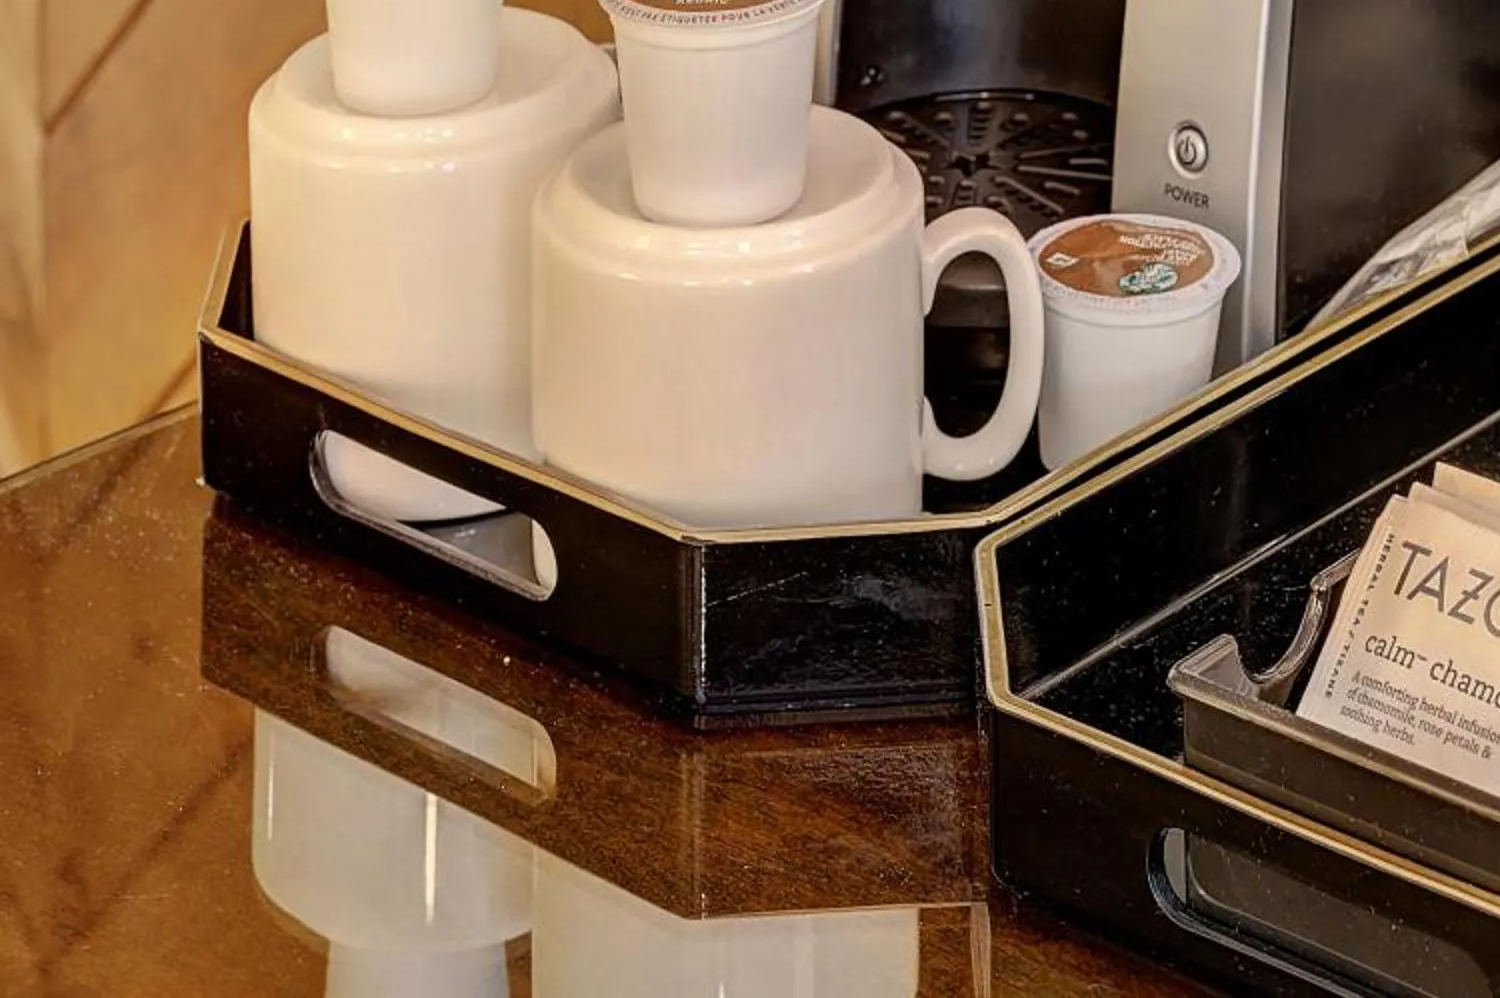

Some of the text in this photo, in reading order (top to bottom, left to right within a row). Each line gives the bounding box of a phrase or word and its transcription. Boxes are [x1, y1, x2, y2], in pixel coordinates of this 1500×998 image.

[1164, 182, 1210, 209] POWER
[1340, 704, 1384, 733] soothing
[1351, 670, 1361, 683] A
[1361, 674, 1420, 710] comforting
[1419, 696, 1458, 725] herbal
[1347, 687, 1361, 700] of
[1418, 718, 1444, 738] rose
[1443, 730, 1480, 755] petals
[1481, 745, 1492, 759] &
